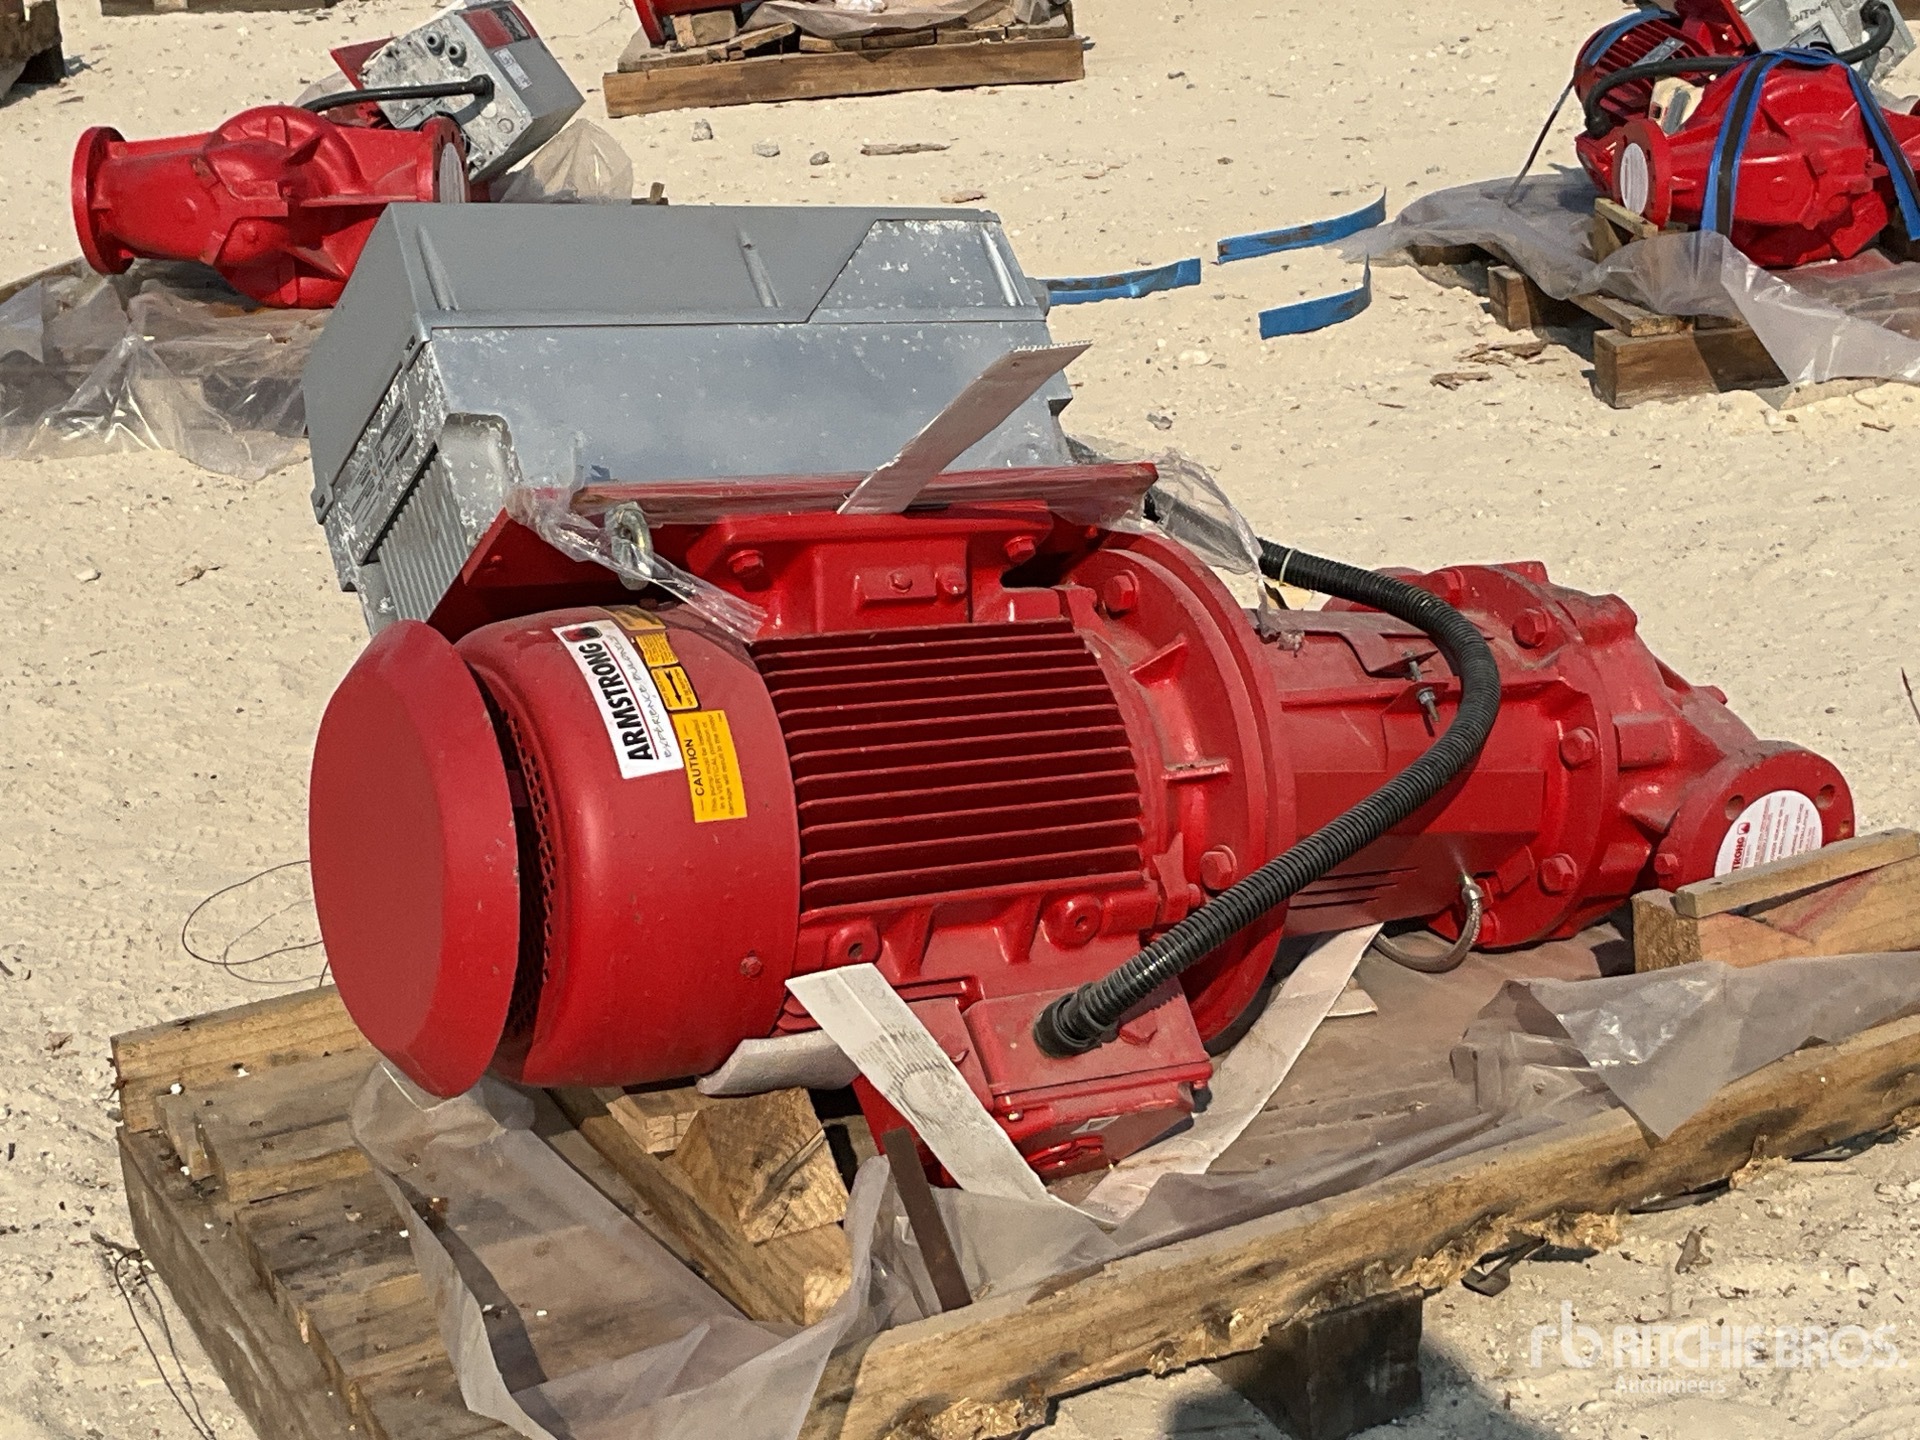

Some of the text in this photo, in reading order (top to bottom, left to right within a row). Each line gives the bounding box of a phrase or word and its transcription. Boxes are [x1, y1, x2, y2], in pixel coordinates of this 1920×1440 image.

[579, 643, 653, 760] ARMSTRONG
[685, 739, 705, 796] CAUTION
[711, 757, 723, 793] VERTICAL
[1733, 836, 1745, 870] TRONG
